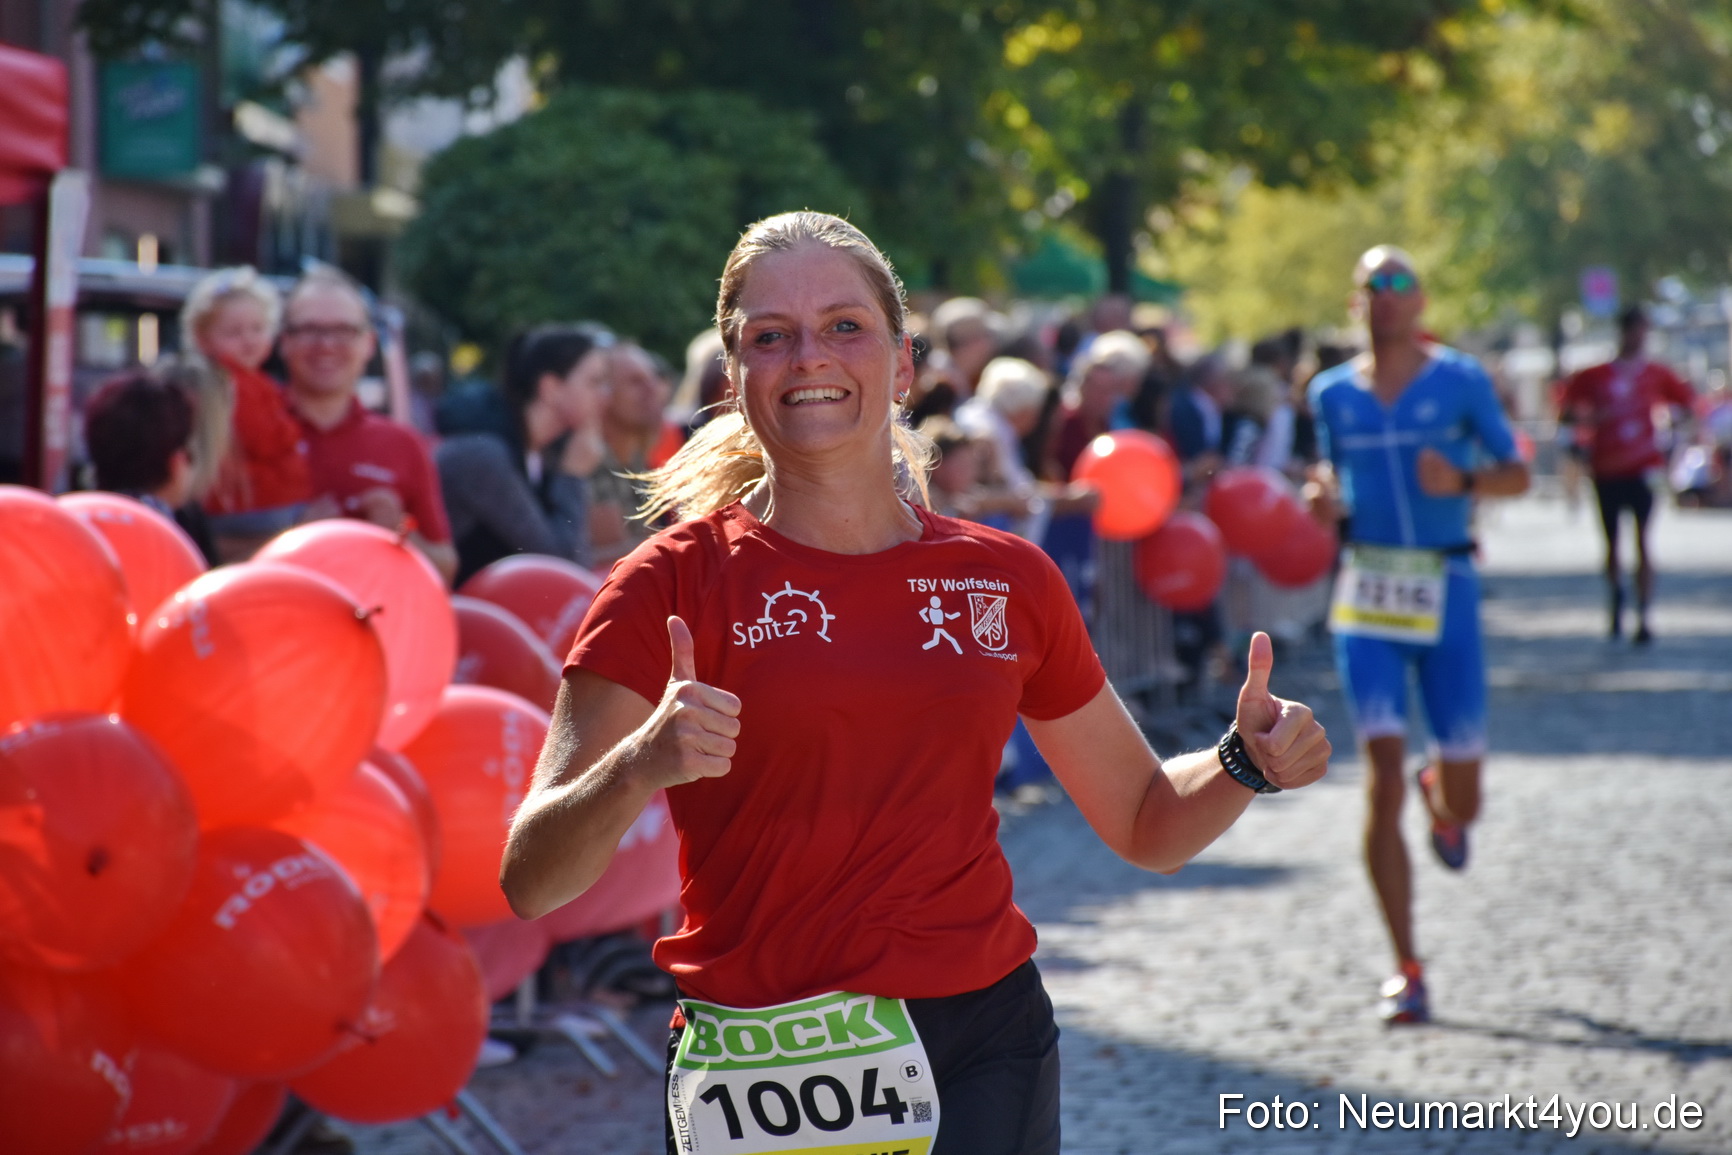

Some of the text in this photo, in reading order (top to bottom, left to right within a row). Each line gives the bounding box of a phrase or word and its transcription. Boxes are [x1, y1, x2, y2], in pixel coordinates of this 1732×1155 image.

[907, 577, 1010, 593] TSV Wolfstein
[732, 617, 800, 649] Spitz
[686, 998, 887, 1061] BOCK
[904, 1064, 919, 1079] B
[699, 1067, 909, 1141] 1004
